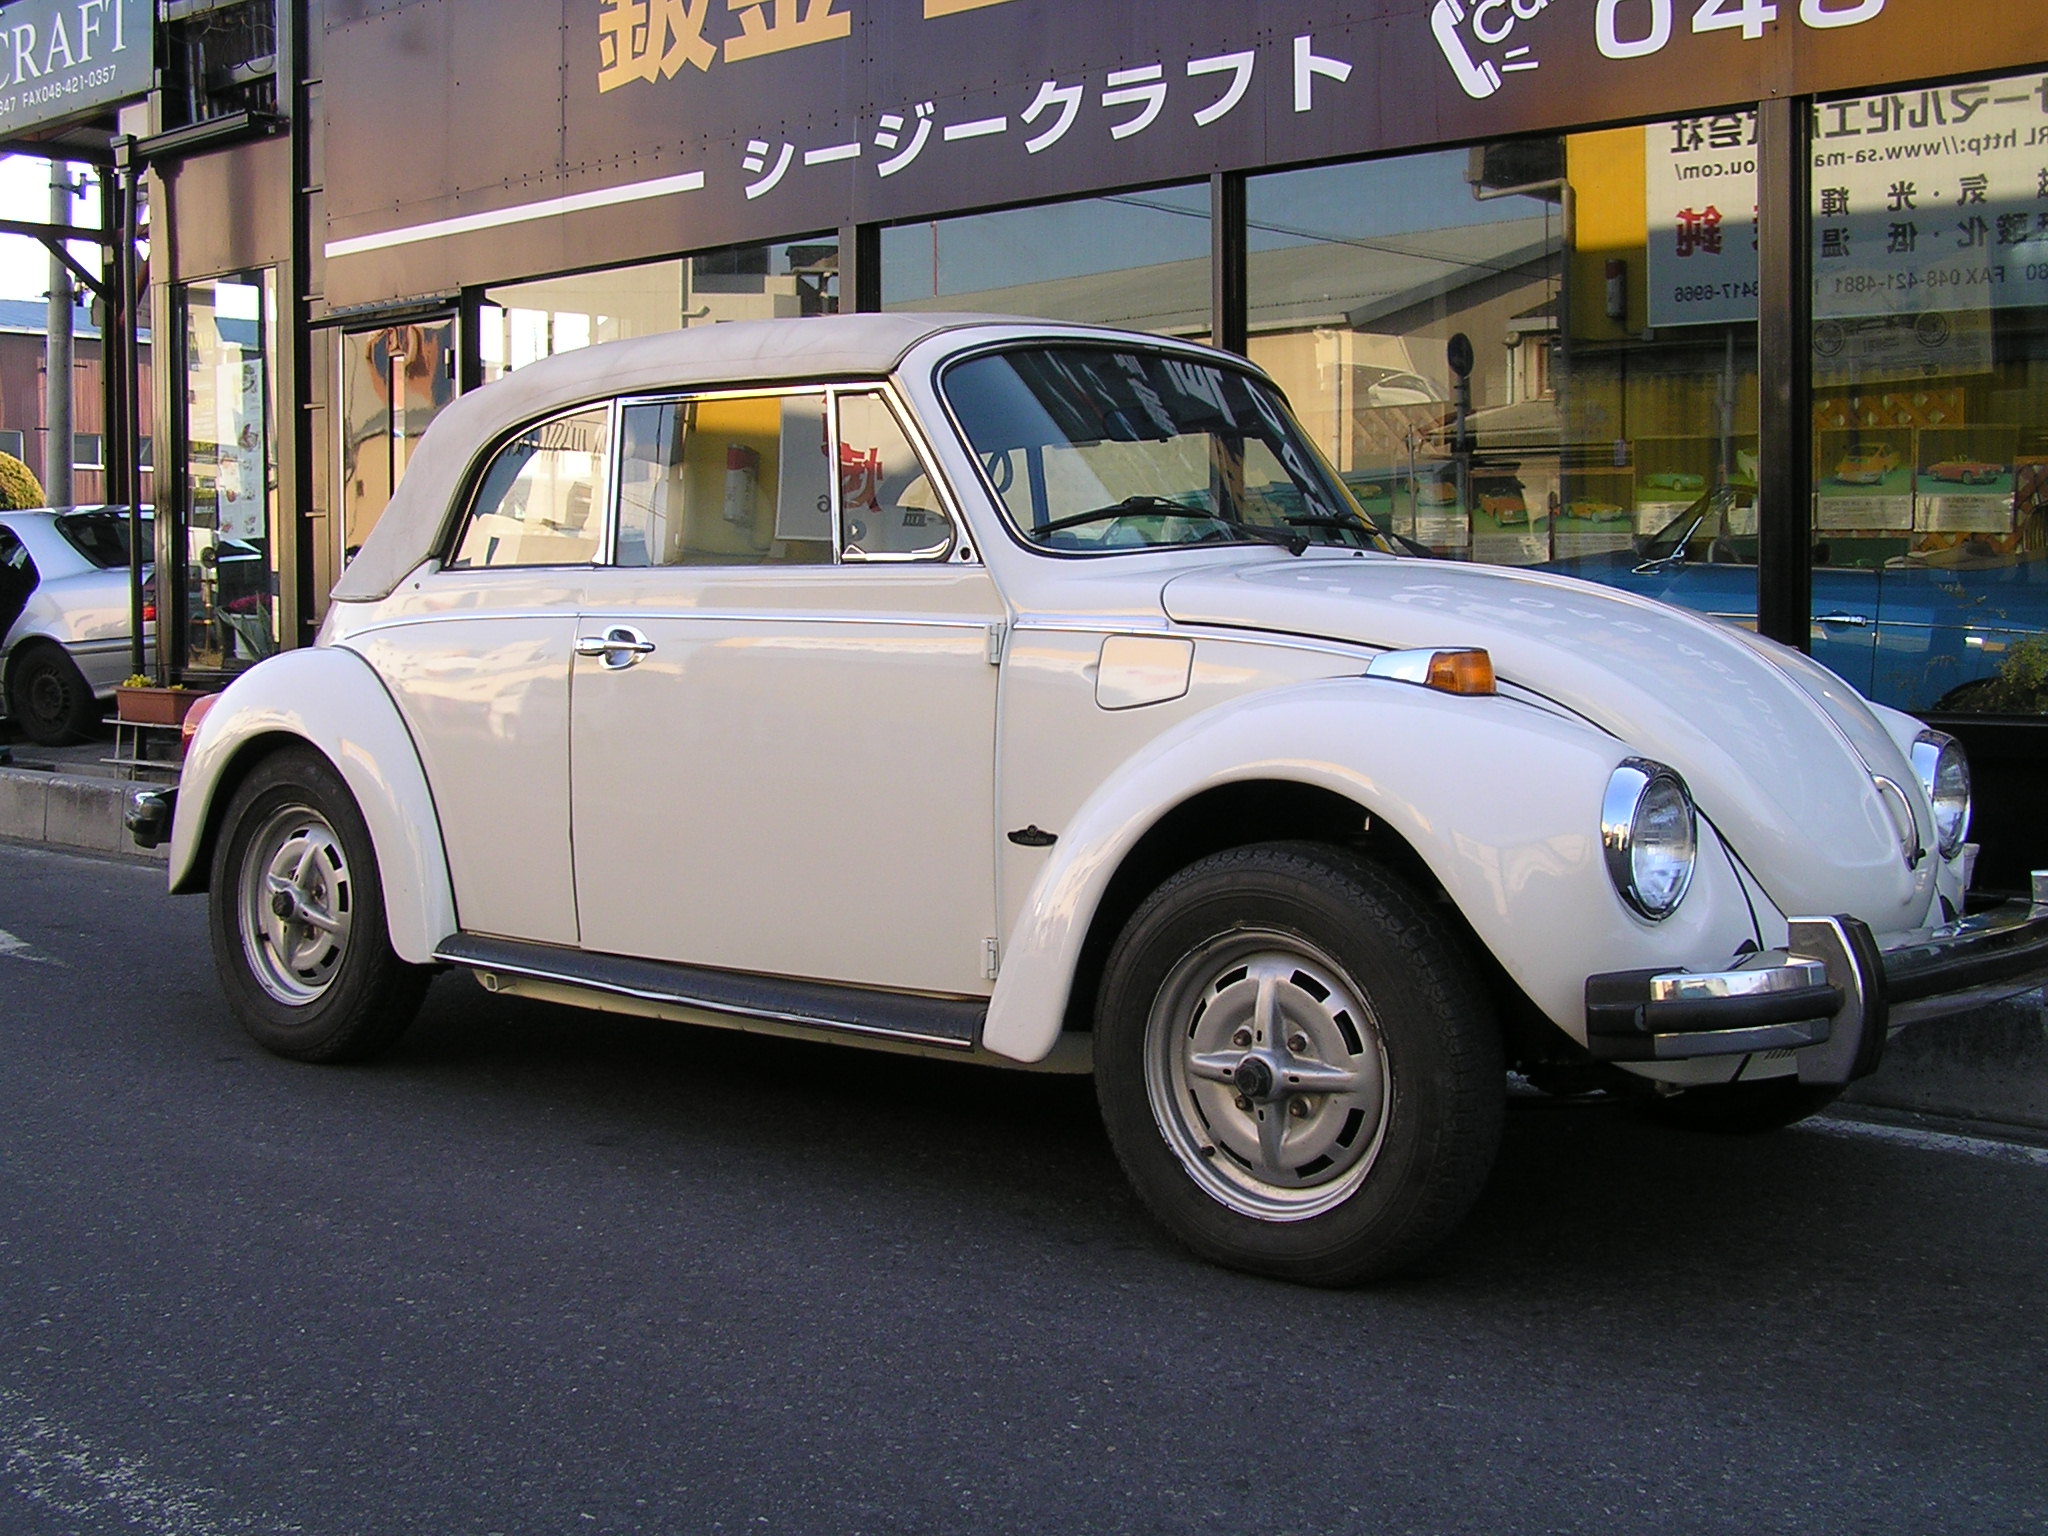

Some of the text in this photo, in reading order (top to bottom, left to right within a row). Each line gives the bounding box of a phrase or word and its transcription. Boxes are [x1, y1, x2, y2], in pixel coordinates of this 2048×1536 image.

[598, 0, 1002, 94] 鈑金
[742, 35, 1353, 200] シージークラフト
